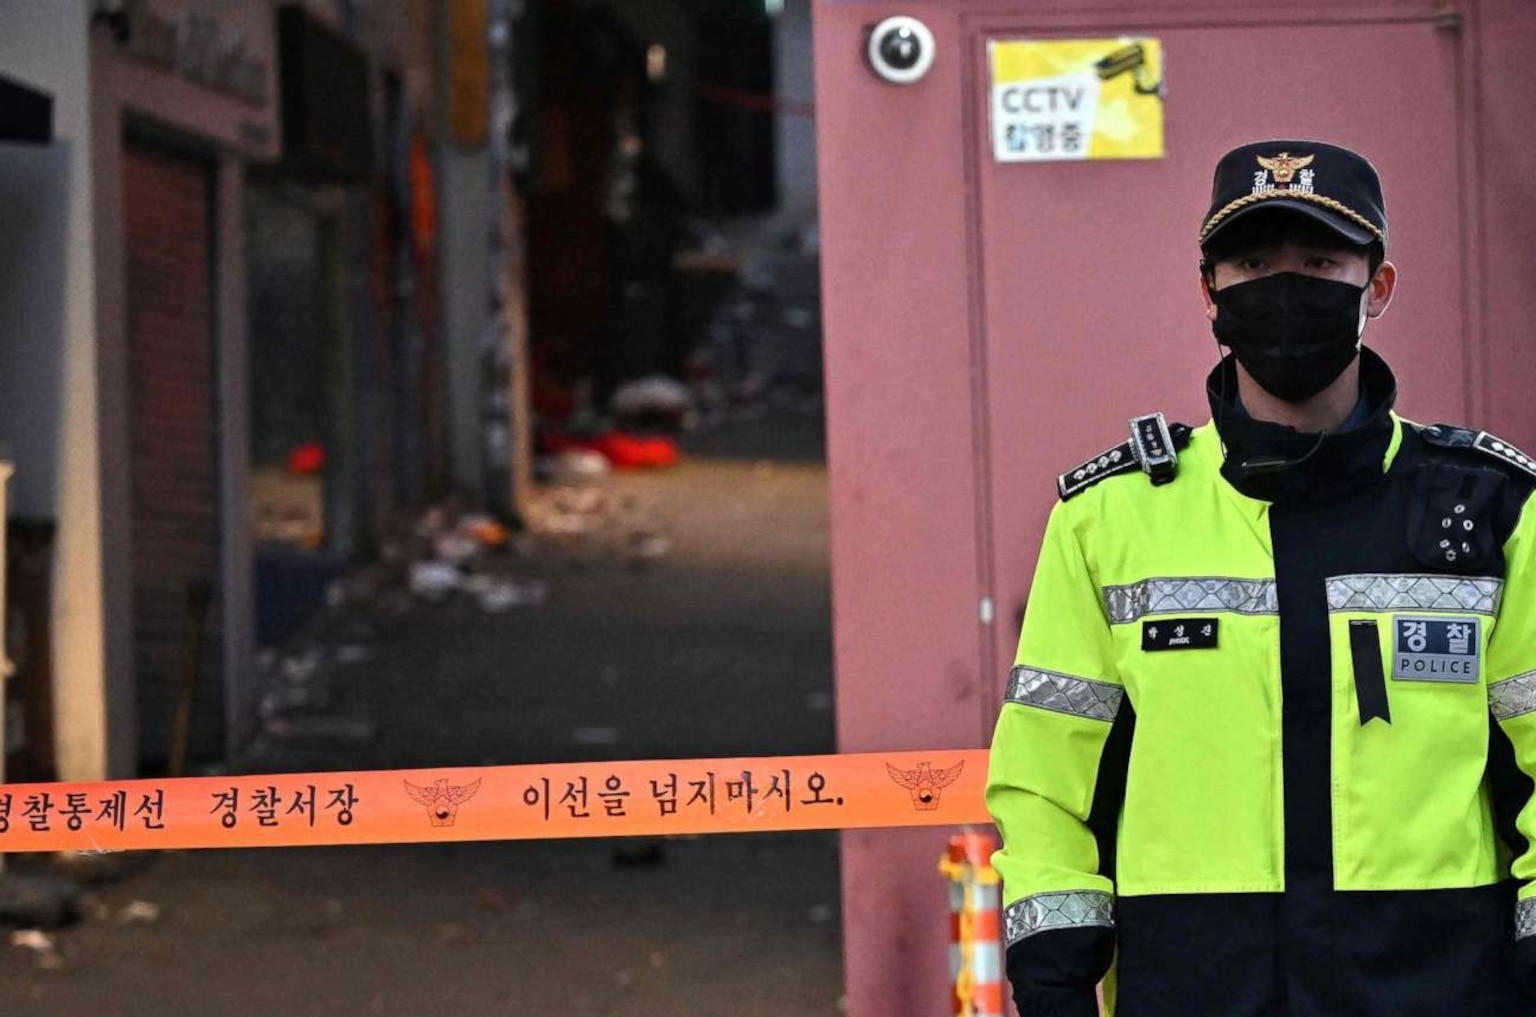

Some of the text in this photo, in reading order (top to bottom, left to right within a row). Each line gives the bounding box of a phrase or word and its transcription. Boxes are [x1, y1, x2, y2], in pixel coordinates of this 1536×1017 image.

[1002, 87, 1084, 113] CCTV
[1402, 622, 1472, 654] 경찰
[1401, 659, 1471, 674] POLICE
[210, 784, 360, 829] 경찰서장
[523, 769, 844, 821] 이선을 넘지마시오.
